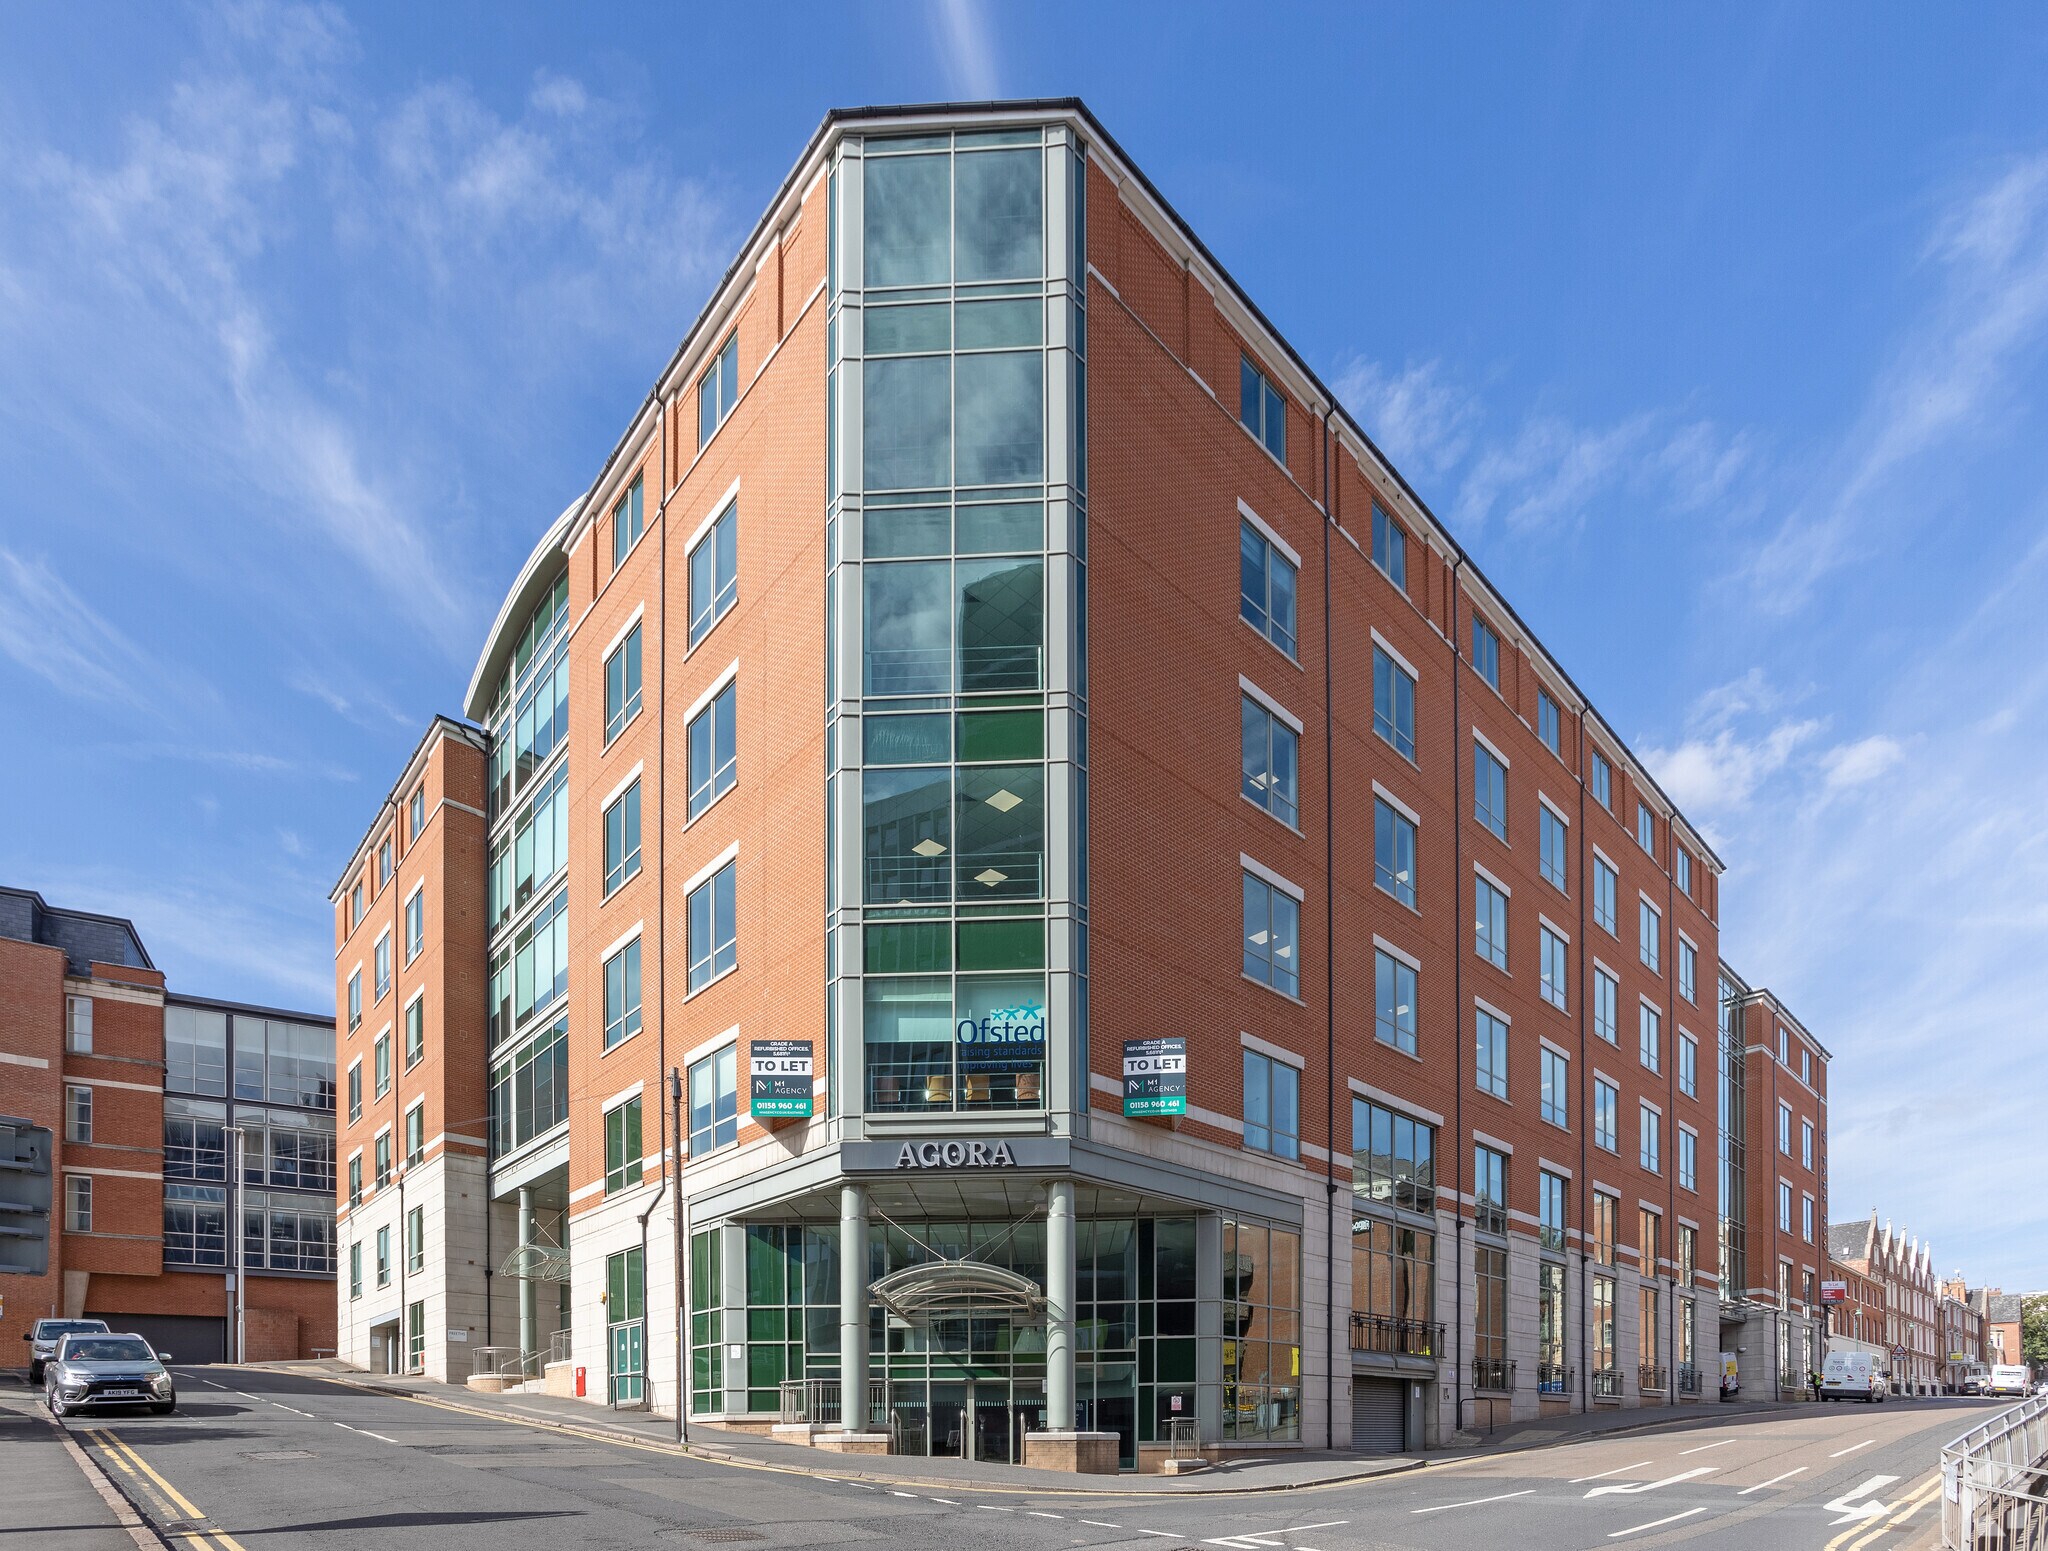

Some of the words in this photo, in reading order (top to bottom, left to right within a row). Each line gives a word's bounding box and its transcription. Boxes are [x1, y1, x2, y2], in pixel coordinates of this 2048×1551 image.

[957, 1017, 1045, 1045] Ofsted
[994, 1045, 1042, 1056] standards
[755, 1061, 776, 1071] TO
[781, 1061, 808, 1071] LET
[1128, 1060, 1149, 1071] TO
[1154, 1059, 1181, 1069] LET
[1151, 1100, 1165, 1108] 960
[1167, 1099, 1180, 1107] 461
[895, 1140, 1014, 1167] AGORA
